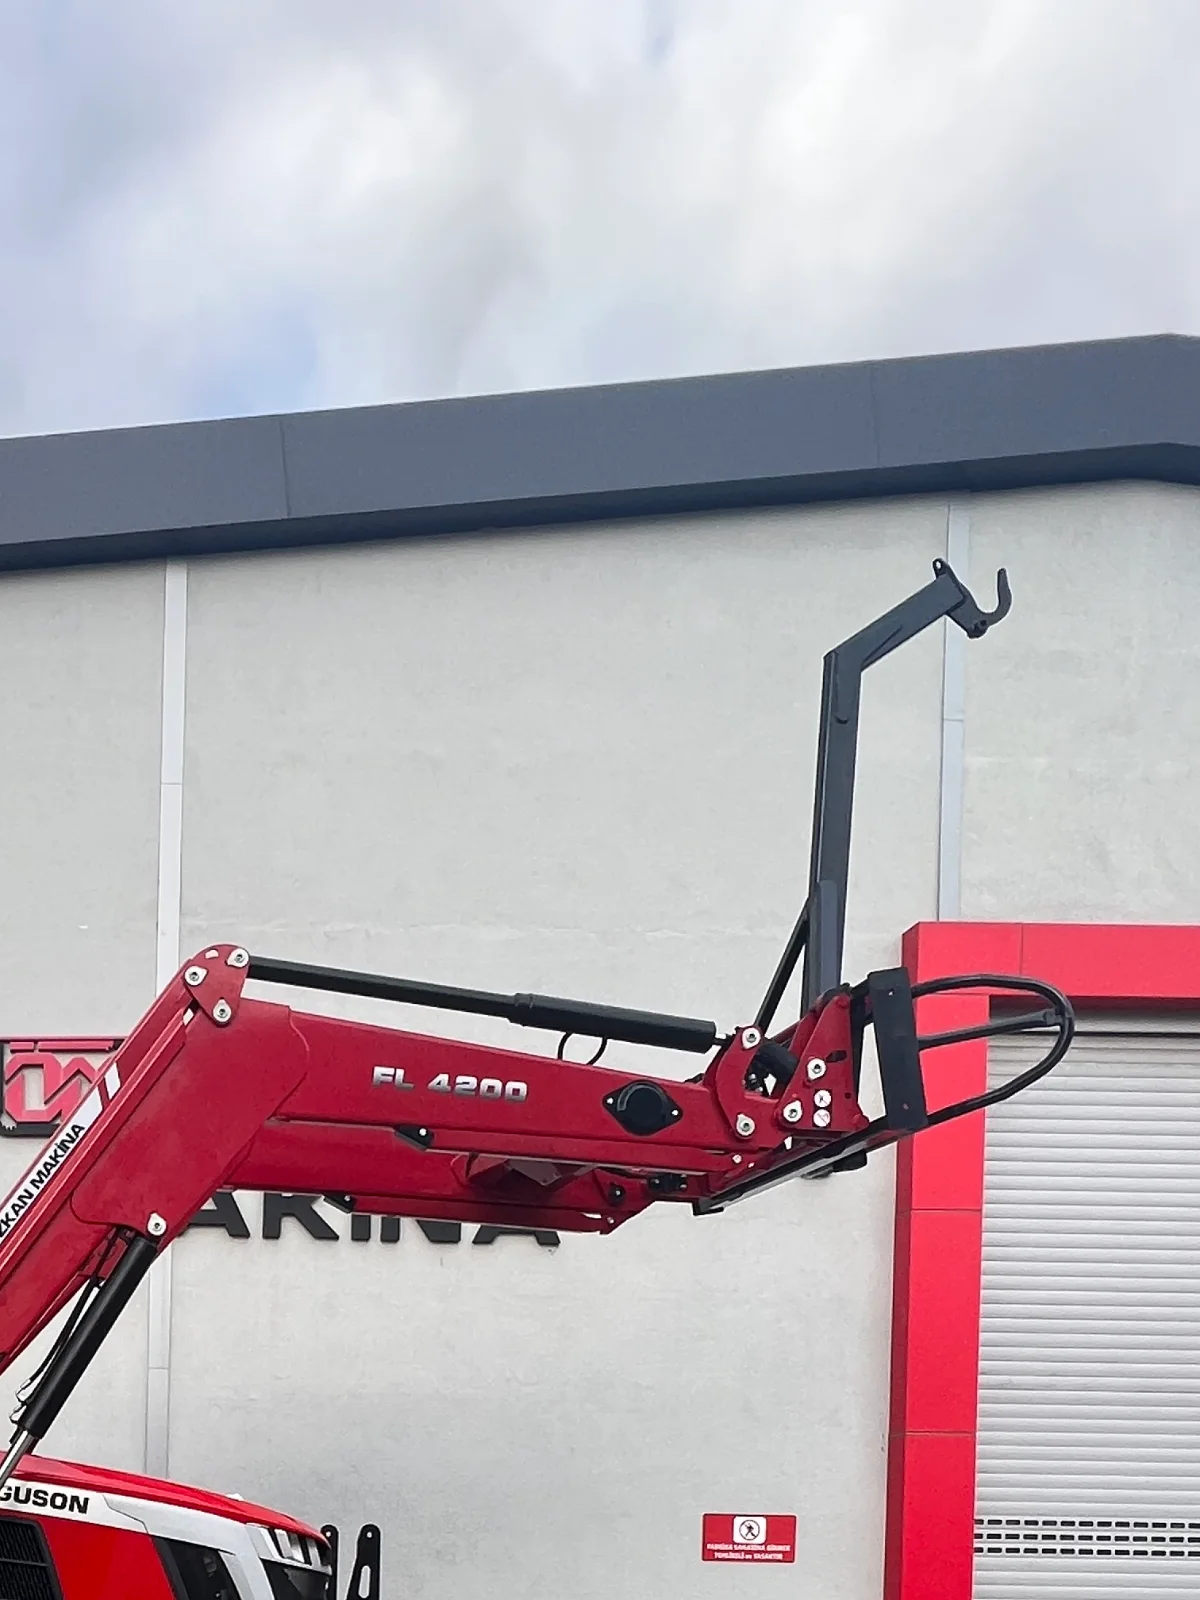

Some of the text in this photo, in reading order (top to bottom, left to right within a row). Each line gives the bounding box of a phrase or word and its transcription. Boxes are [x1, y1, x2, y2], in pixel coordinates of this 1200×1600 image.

[372, 1066, 528, 1101] FL 4200
[29, 1123, 86, 1190] MAKİNA
